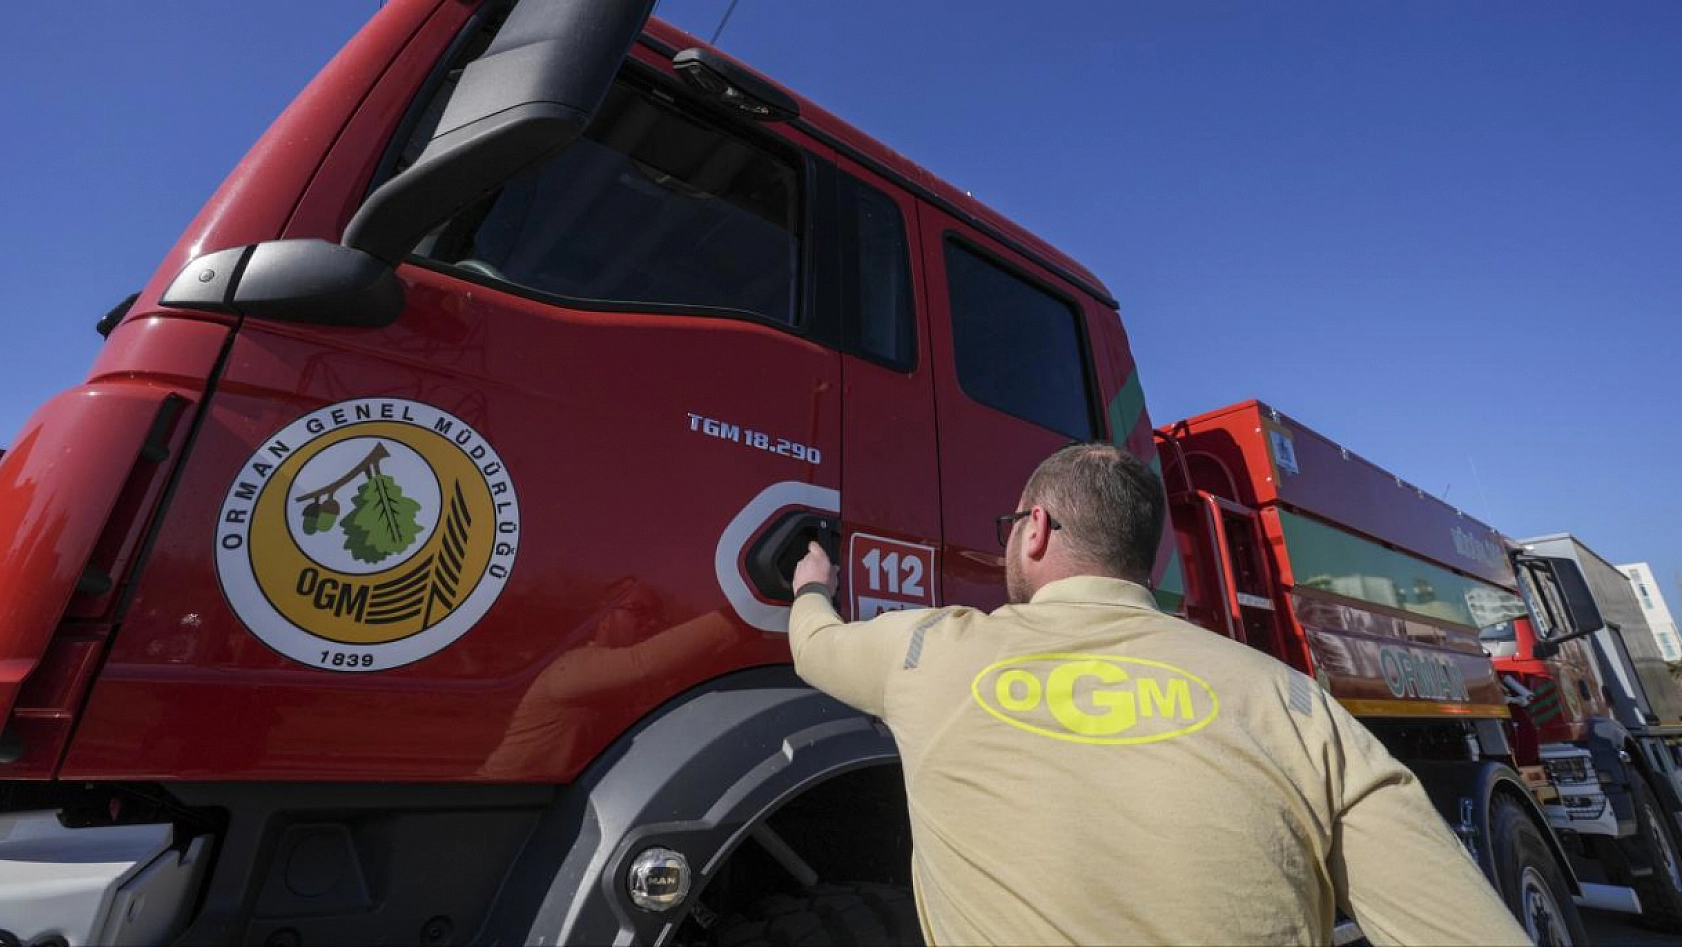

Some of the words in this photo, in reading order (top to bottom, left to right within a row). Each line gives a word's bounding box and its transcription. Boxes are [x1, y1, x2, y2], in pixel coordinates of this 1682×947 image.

[687, 412, 740, 443] TGM
[744, 429, 821, 465] 18.290
[222, 440, 290, 550] ORMAN
[306, 403, 415, 434] GENEL
[434, 416, 518, 580] MÜDÜRLÜĞÜ
[296, 567, 370, 624] OGM
[861, 548, 925, 597] 112
[320, 650, 375, 668] 1839
[996, 660, 1195, 735] OGM
